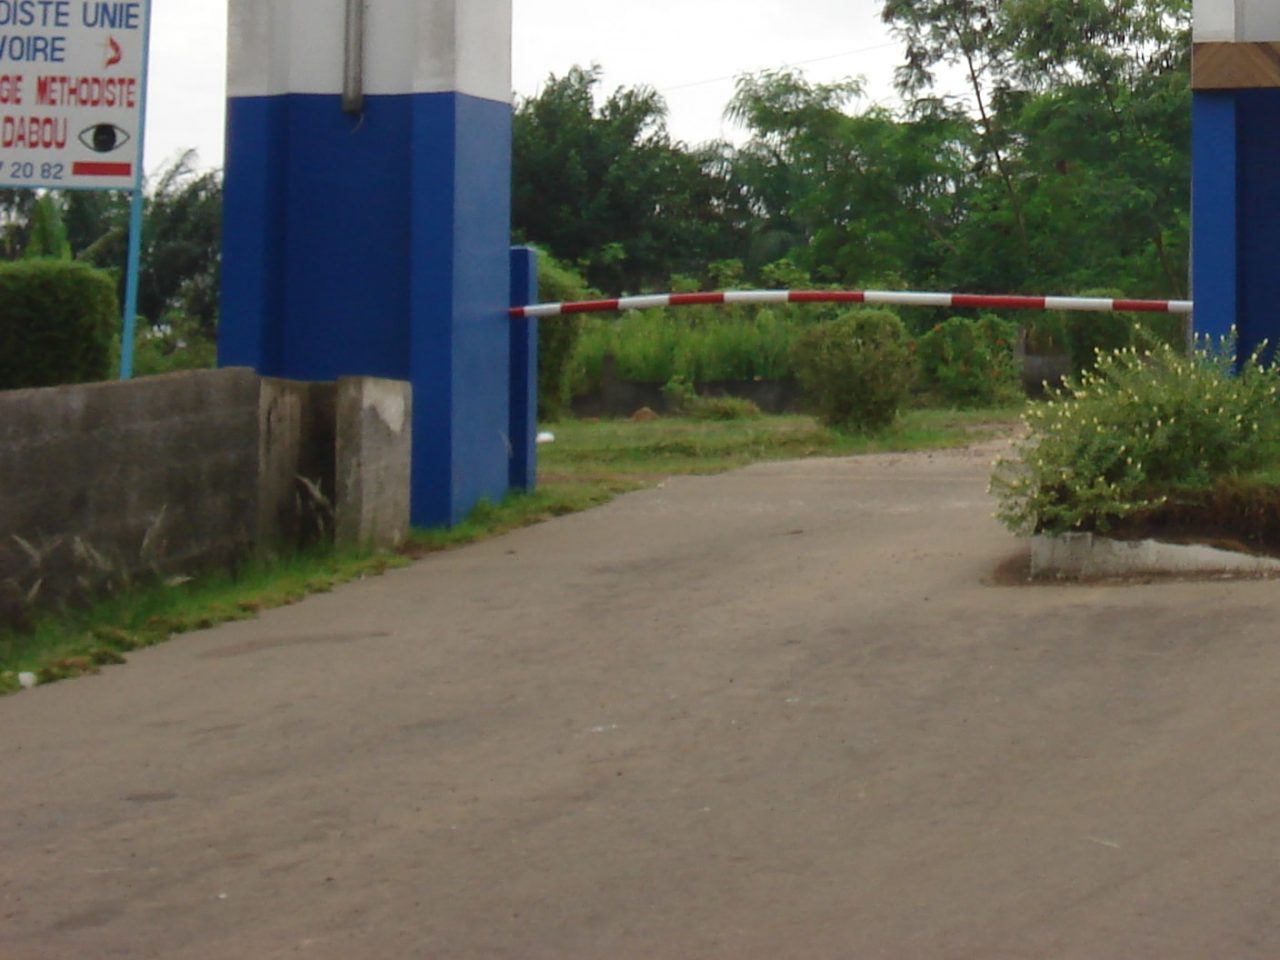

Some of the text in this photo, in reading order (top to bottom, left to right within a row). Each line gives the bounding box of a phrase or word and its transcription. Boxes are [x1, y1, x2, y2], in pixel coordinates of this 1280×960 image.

[83, 1, 140, 28] UNIE
[36, 74, 136, 108] METHODISTE
[2, 115, 67, 149] DABOU
